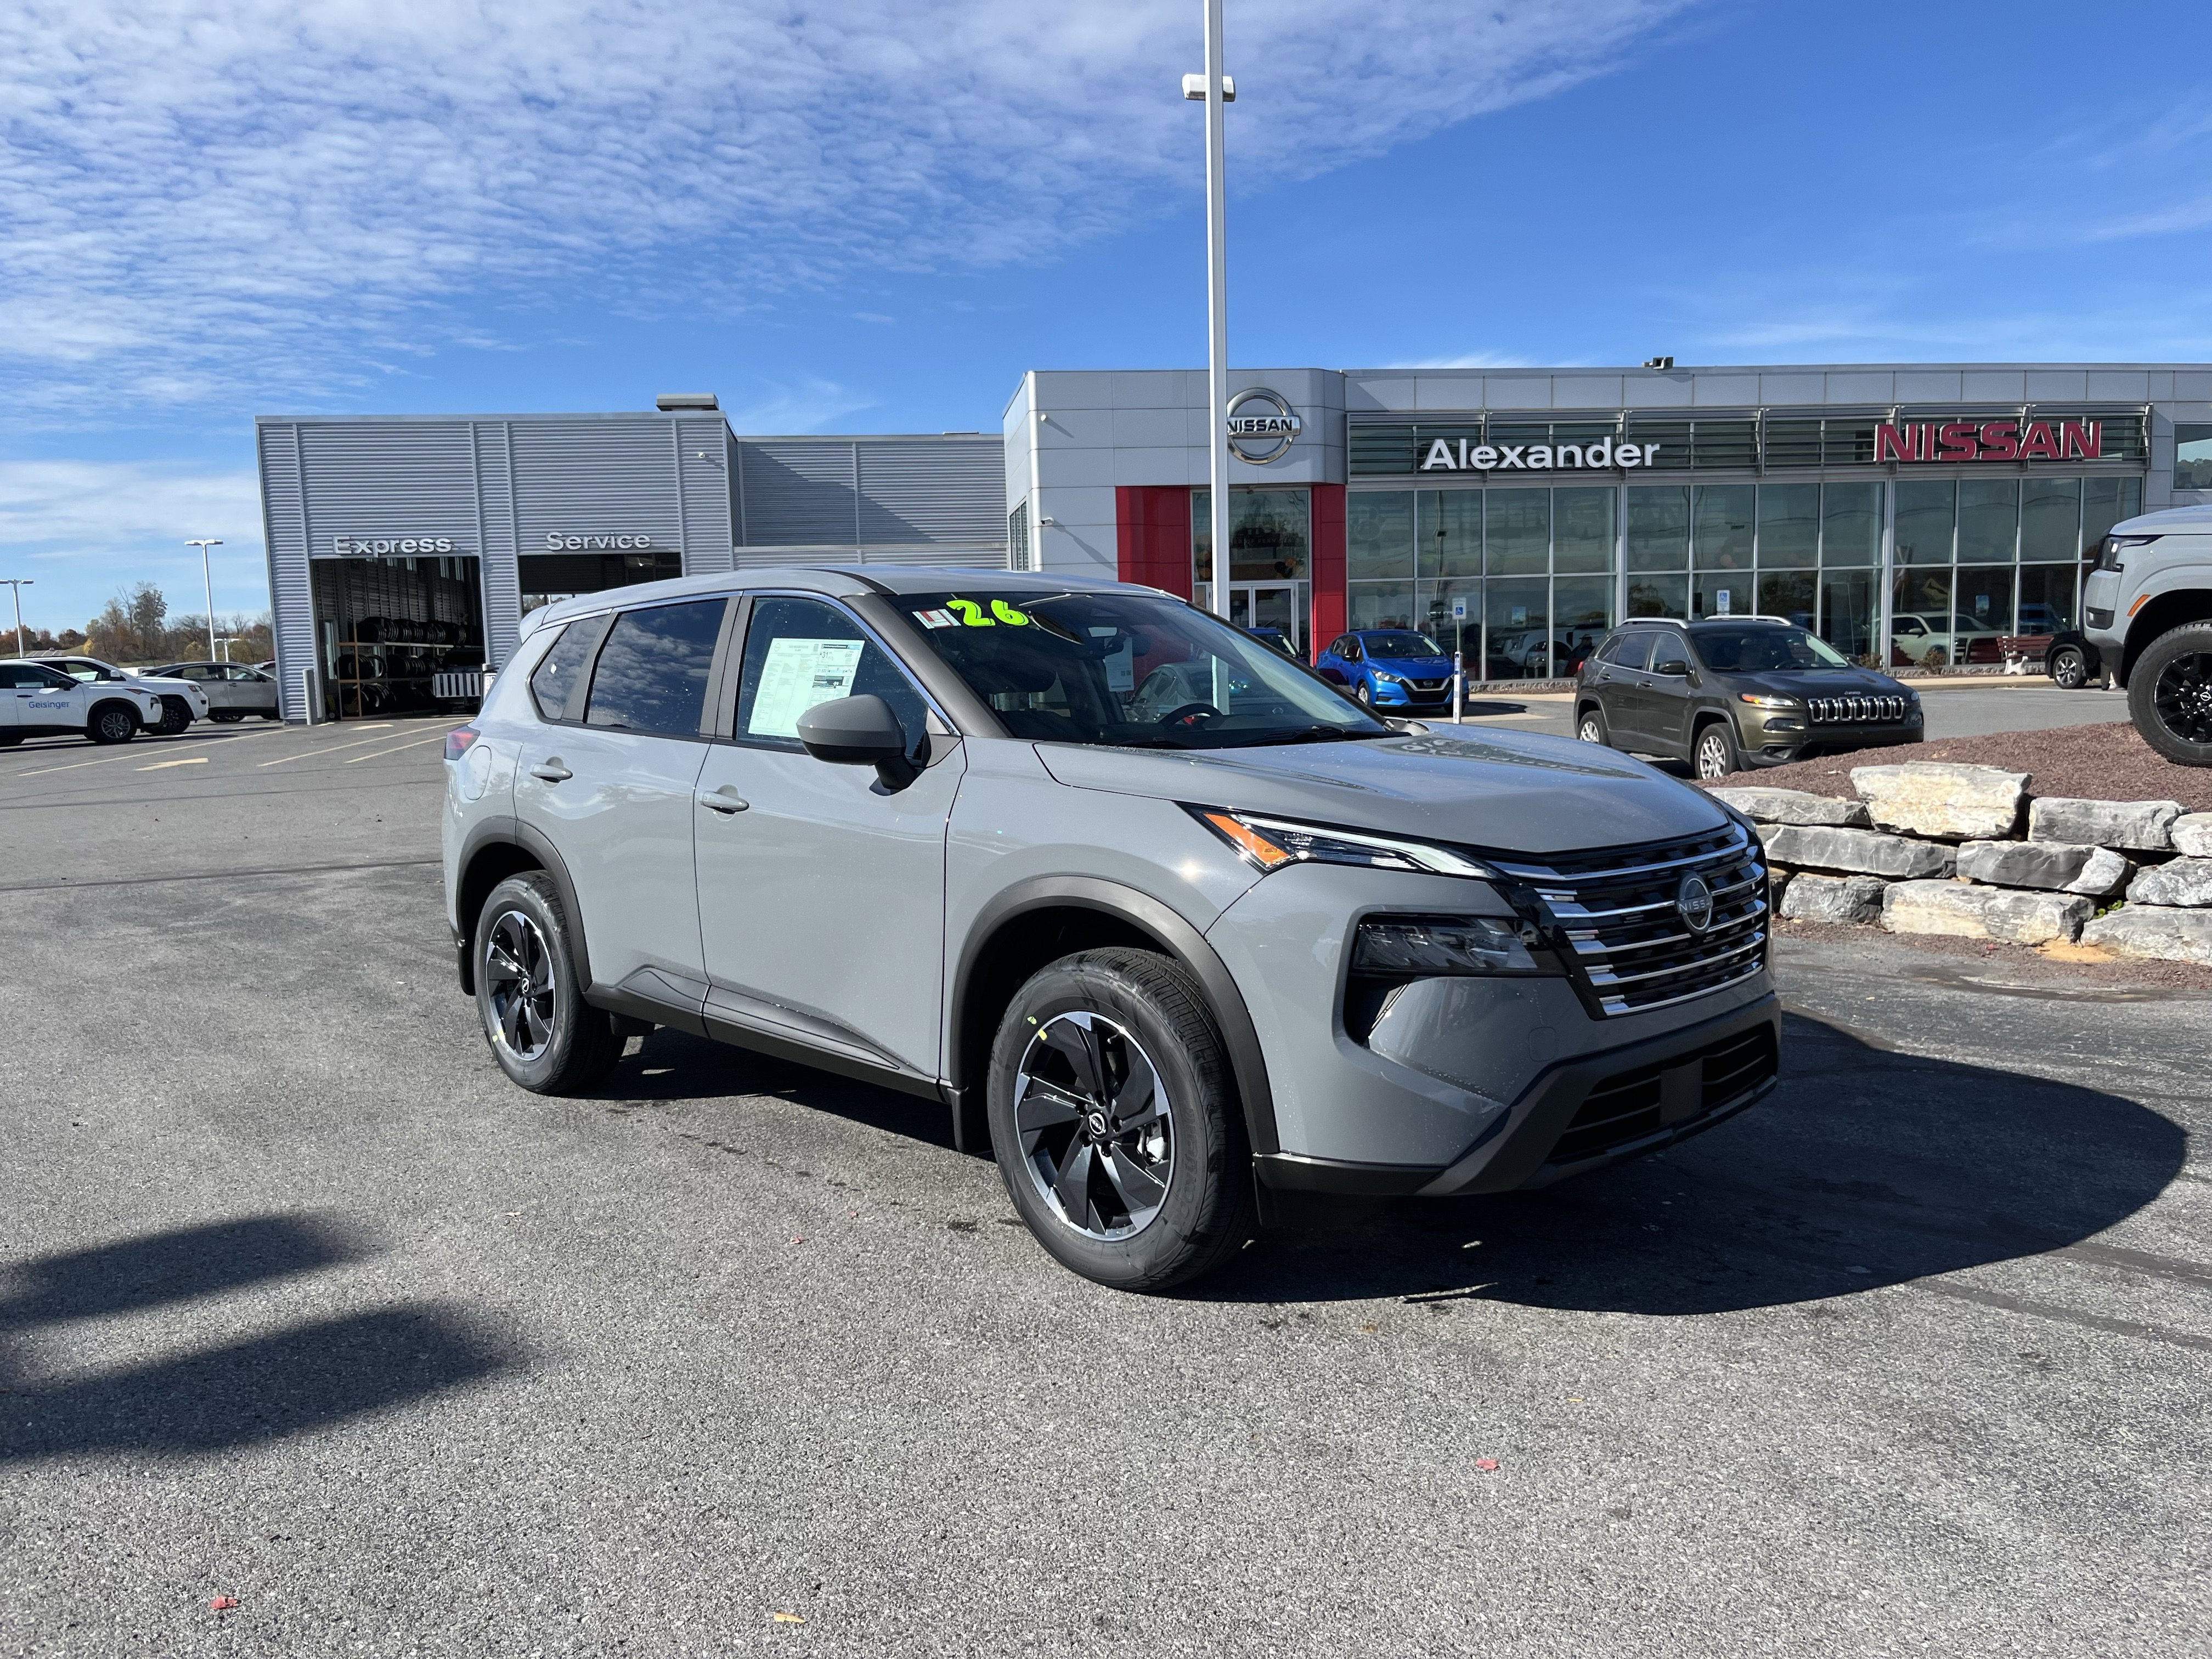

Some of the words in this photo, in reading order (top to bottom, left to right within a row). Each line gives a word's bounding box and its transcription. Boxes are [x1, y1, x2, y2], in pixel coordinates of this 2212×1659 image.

[1227, 419, 1293, 432] NISSAN
[1874, 422, 2102, 461] NISSAN
[1422, 437, 1660, 470] Alexander
[332, 535, 452, 558] Express
[546, 532, 651, 550] Service
[946, 599, 1029, 627] 26
[29, 701, 70, 709] Geisinger
[1679, 898, 1711, 911] NISS
